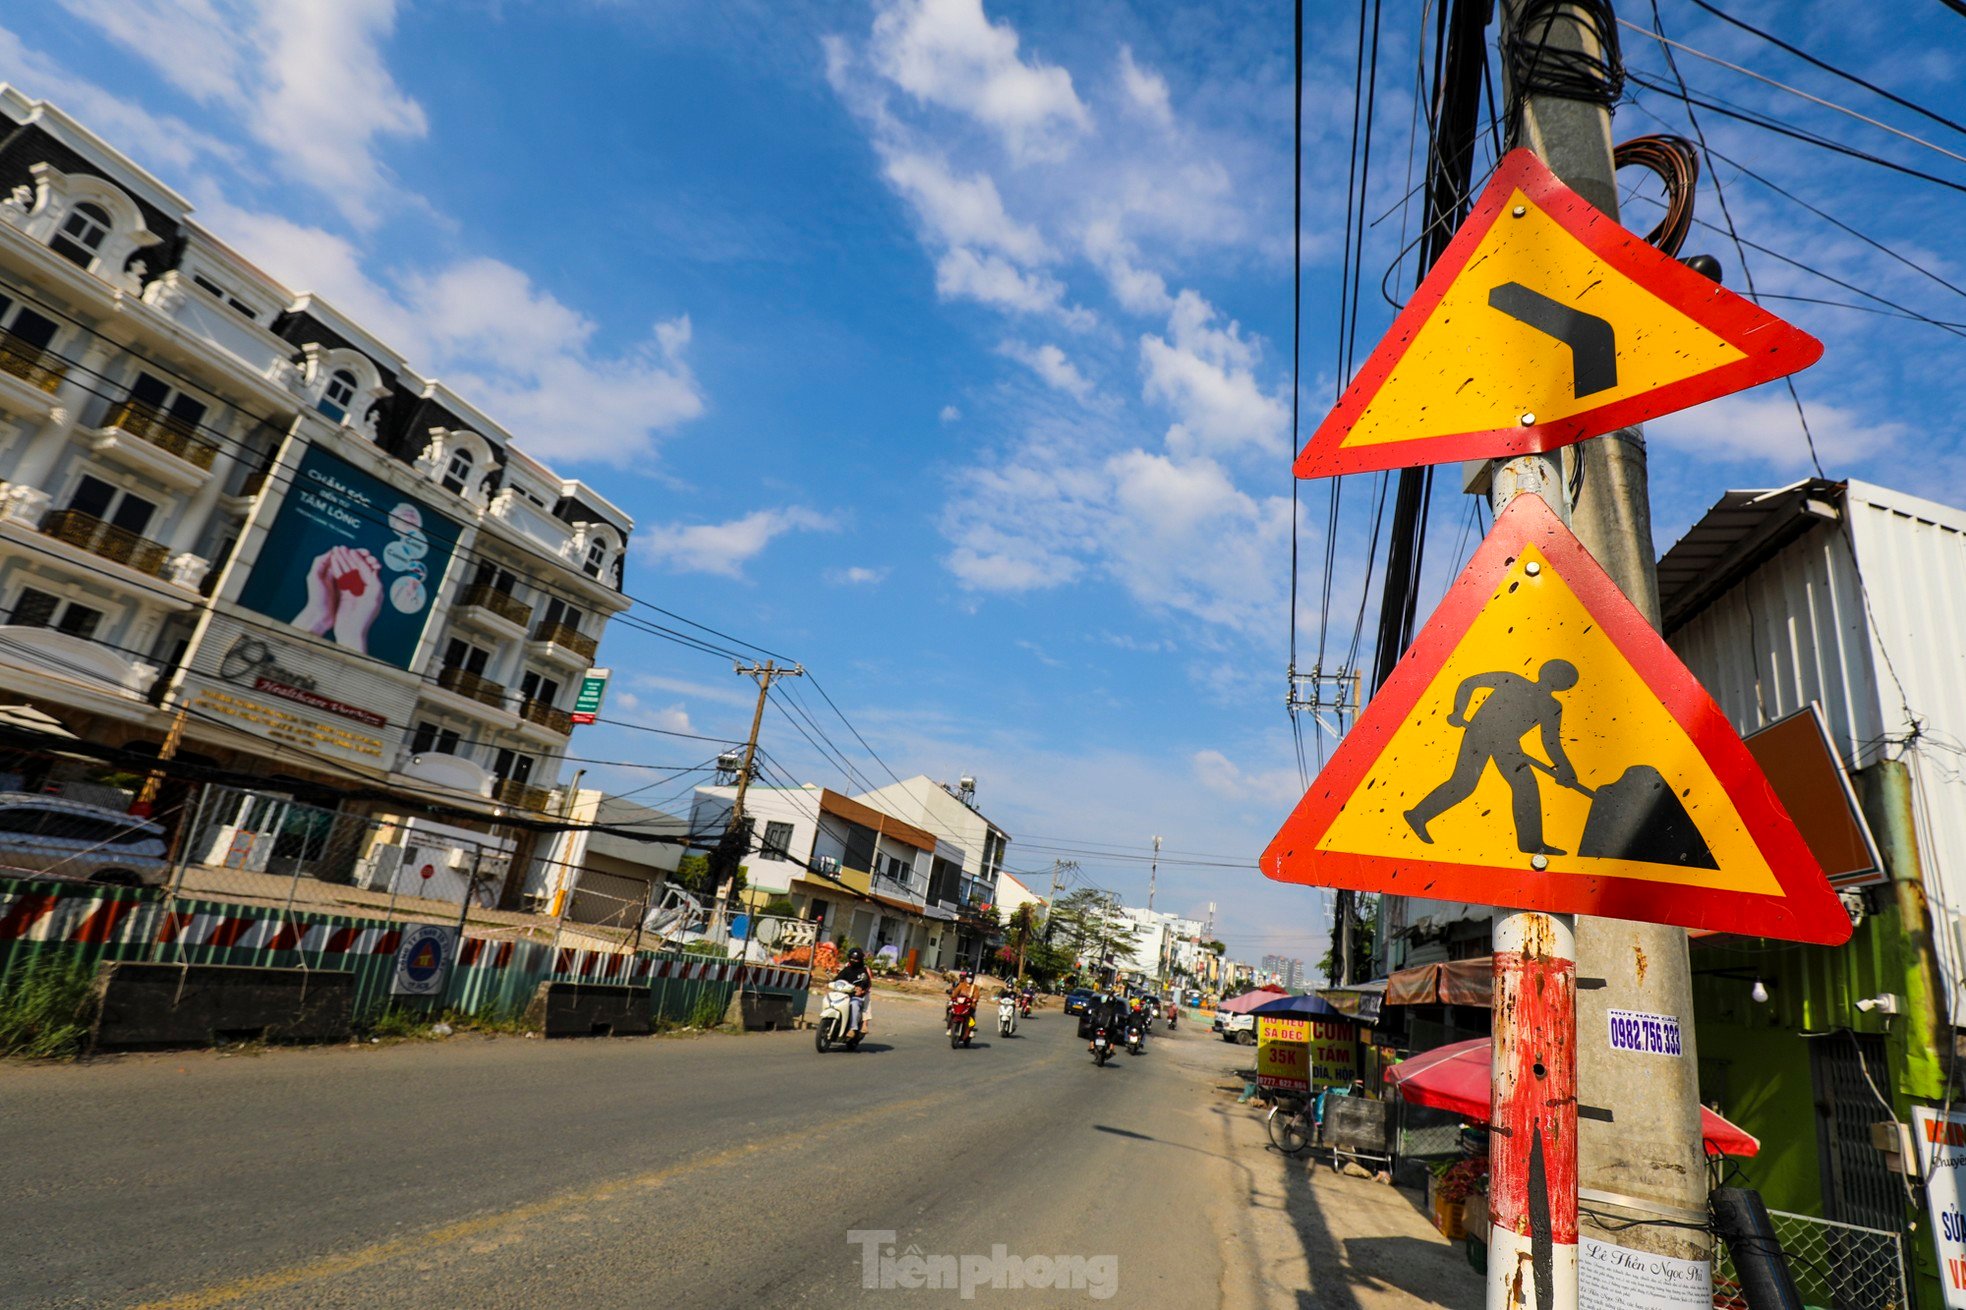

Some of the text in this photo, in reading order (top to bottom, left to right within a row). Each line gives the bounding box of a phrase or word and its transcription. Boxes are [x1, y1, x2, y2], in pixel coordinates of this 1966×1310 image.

[1264, 1027, 1278, 1038] SA
[1610, 1016, 1681, 1056] 0982.756.333
[1269, 1047, 1296, 1064] 35K
[1585, 1243, 1608, 1262] Lê
[1650, 1261, 1684, 1281] Ngọc
